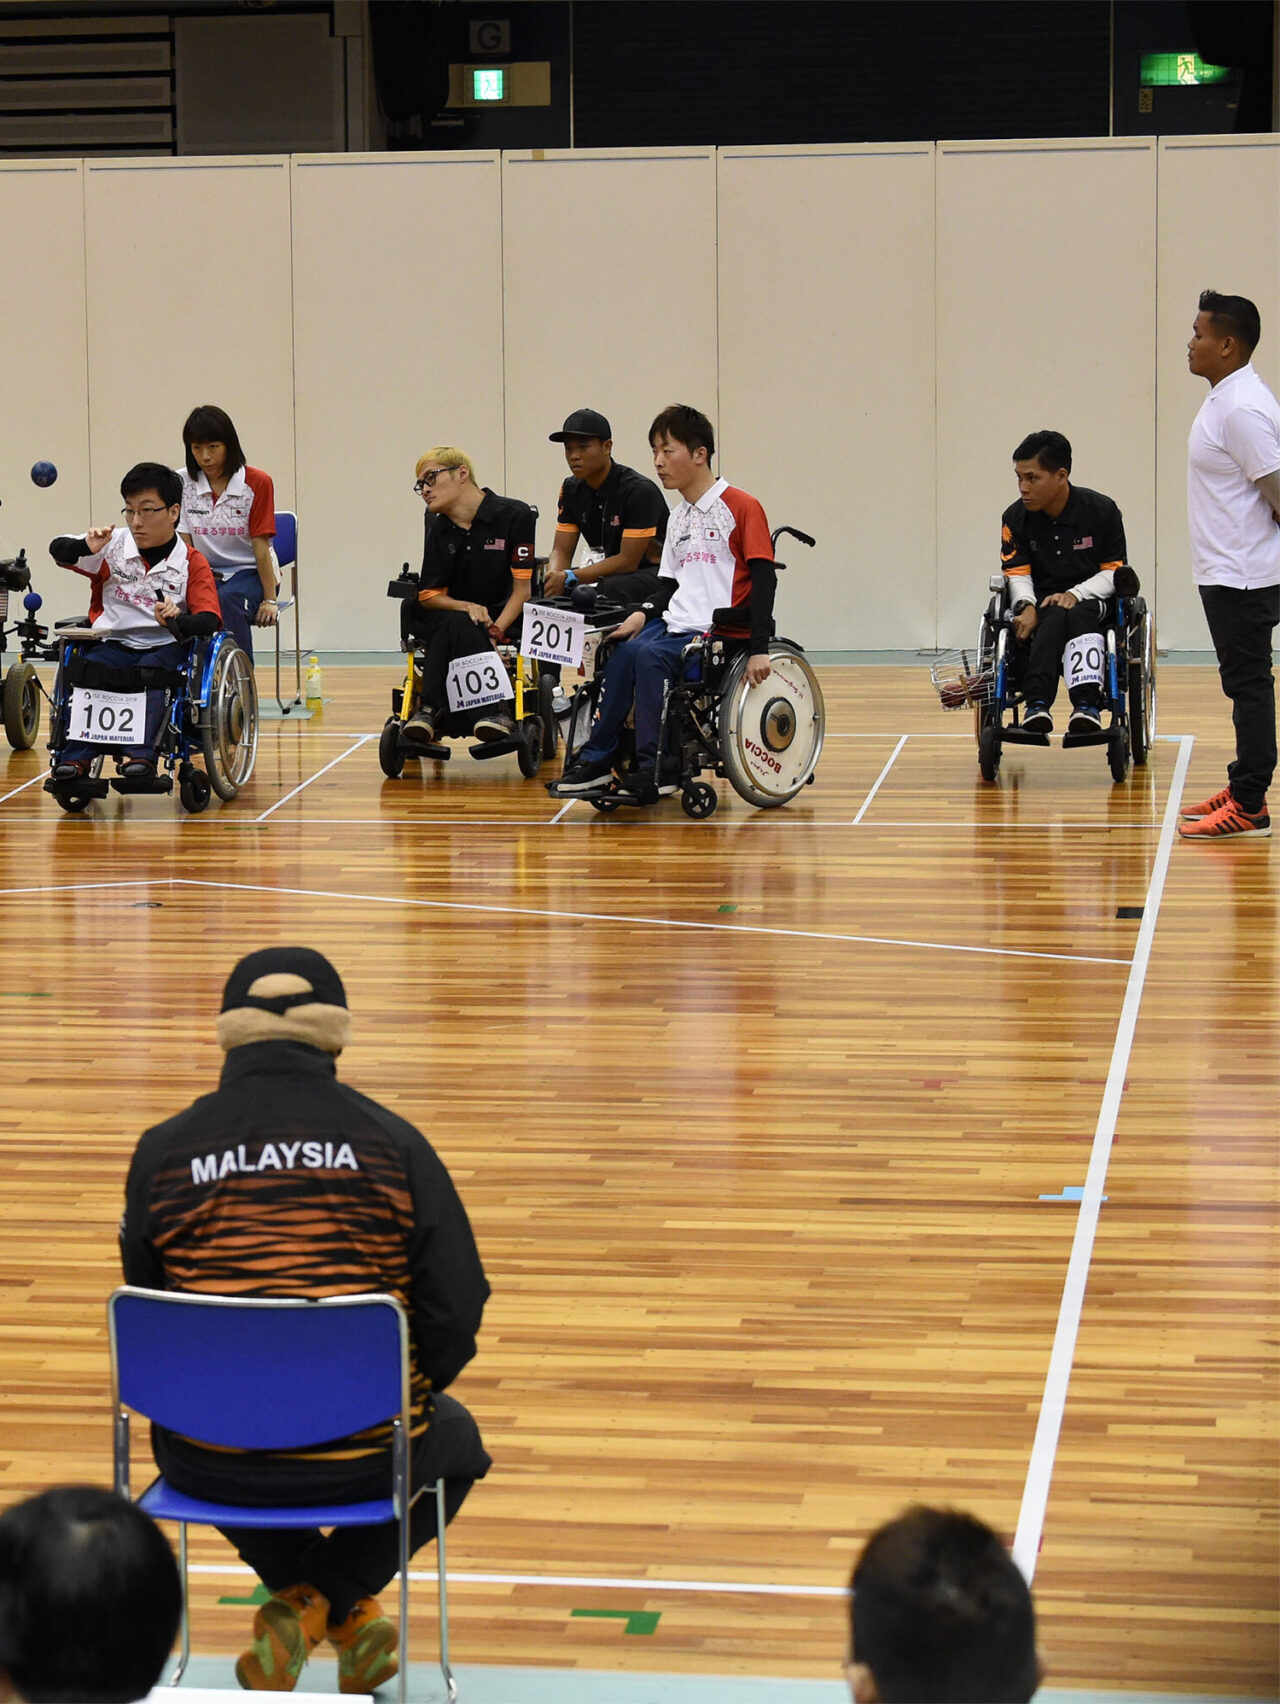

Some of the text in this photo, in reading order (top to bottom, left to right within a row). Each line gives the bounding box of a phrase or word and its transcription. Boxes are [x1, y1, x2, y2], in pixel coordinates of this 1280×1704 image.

[478, 22, 502, 50] G
[517, 546, 529, 557] C
[546, 611, 565, 619] BOCCIA
[530, 620, 573, 652] 201
[461, 657, 483, 666] BOCCIA
[538, 650, 552, 659] JAPAN
[552, 653, 573, 664] MATERIAL
[452, 666, 500, 698] 103
[1080, 674, 1097, 682] JAPAN
[102, 694, 124, 702] BOCCIA
[465, 698, 481, 707] JAPAN
[481, 692, 506, 703] MATERIAL
[83, 704, 134, 732] 102
[91, 733, 108, 741] JAPAN
[745, 738, 782, 774] BOCCIA
[190, 1140, 359, 1185] MALAYSIA
